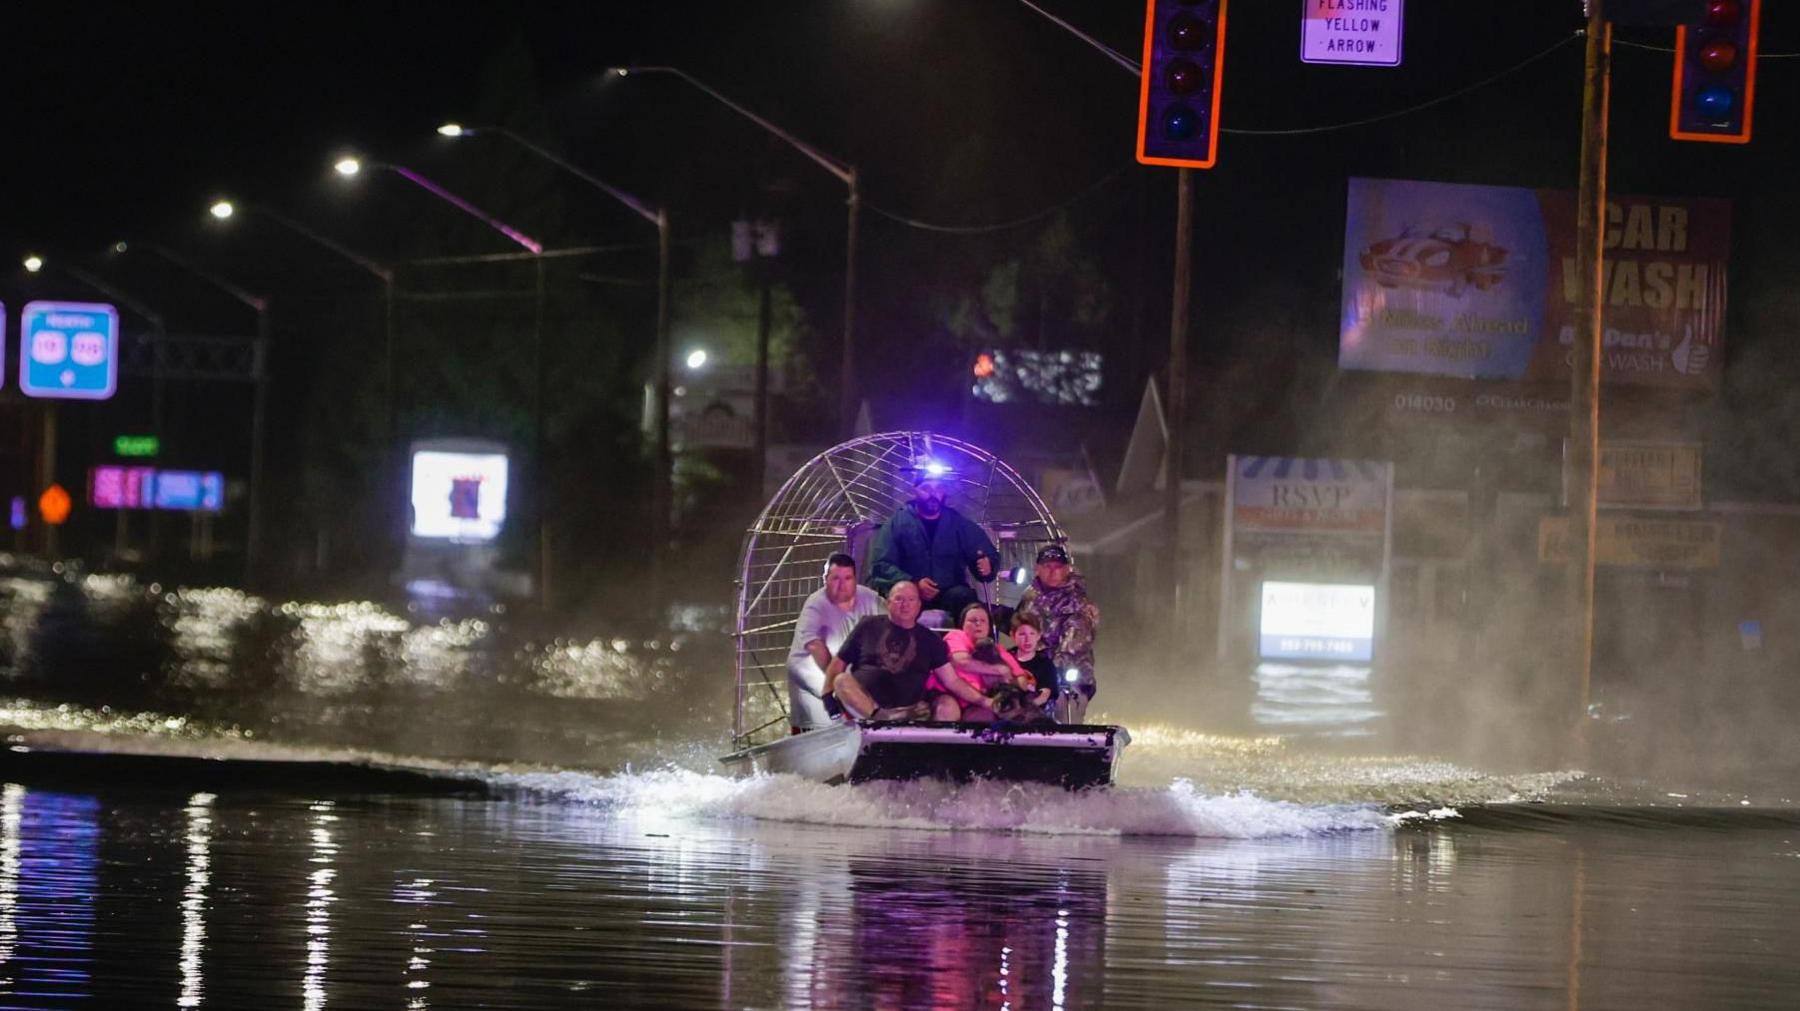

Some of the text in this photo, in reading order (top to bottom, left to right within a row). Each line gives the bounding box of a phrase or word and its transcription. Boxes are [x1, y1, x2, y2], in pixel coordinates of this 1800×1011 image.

[1319, 0, 1387, 11] FLASHING
[1326, 18, 1379, 32] YELLOW
[1327, 39, 1375, 53] ARROW
[1602, 204, 1688, 251] CAR
[1604, 328, 1671, 349] Dan's
[1608, 353, 1664, 373] WASH
[1394, 393, 1456, 413] 014030
[1272, 484, 1351, 508] RSVP
